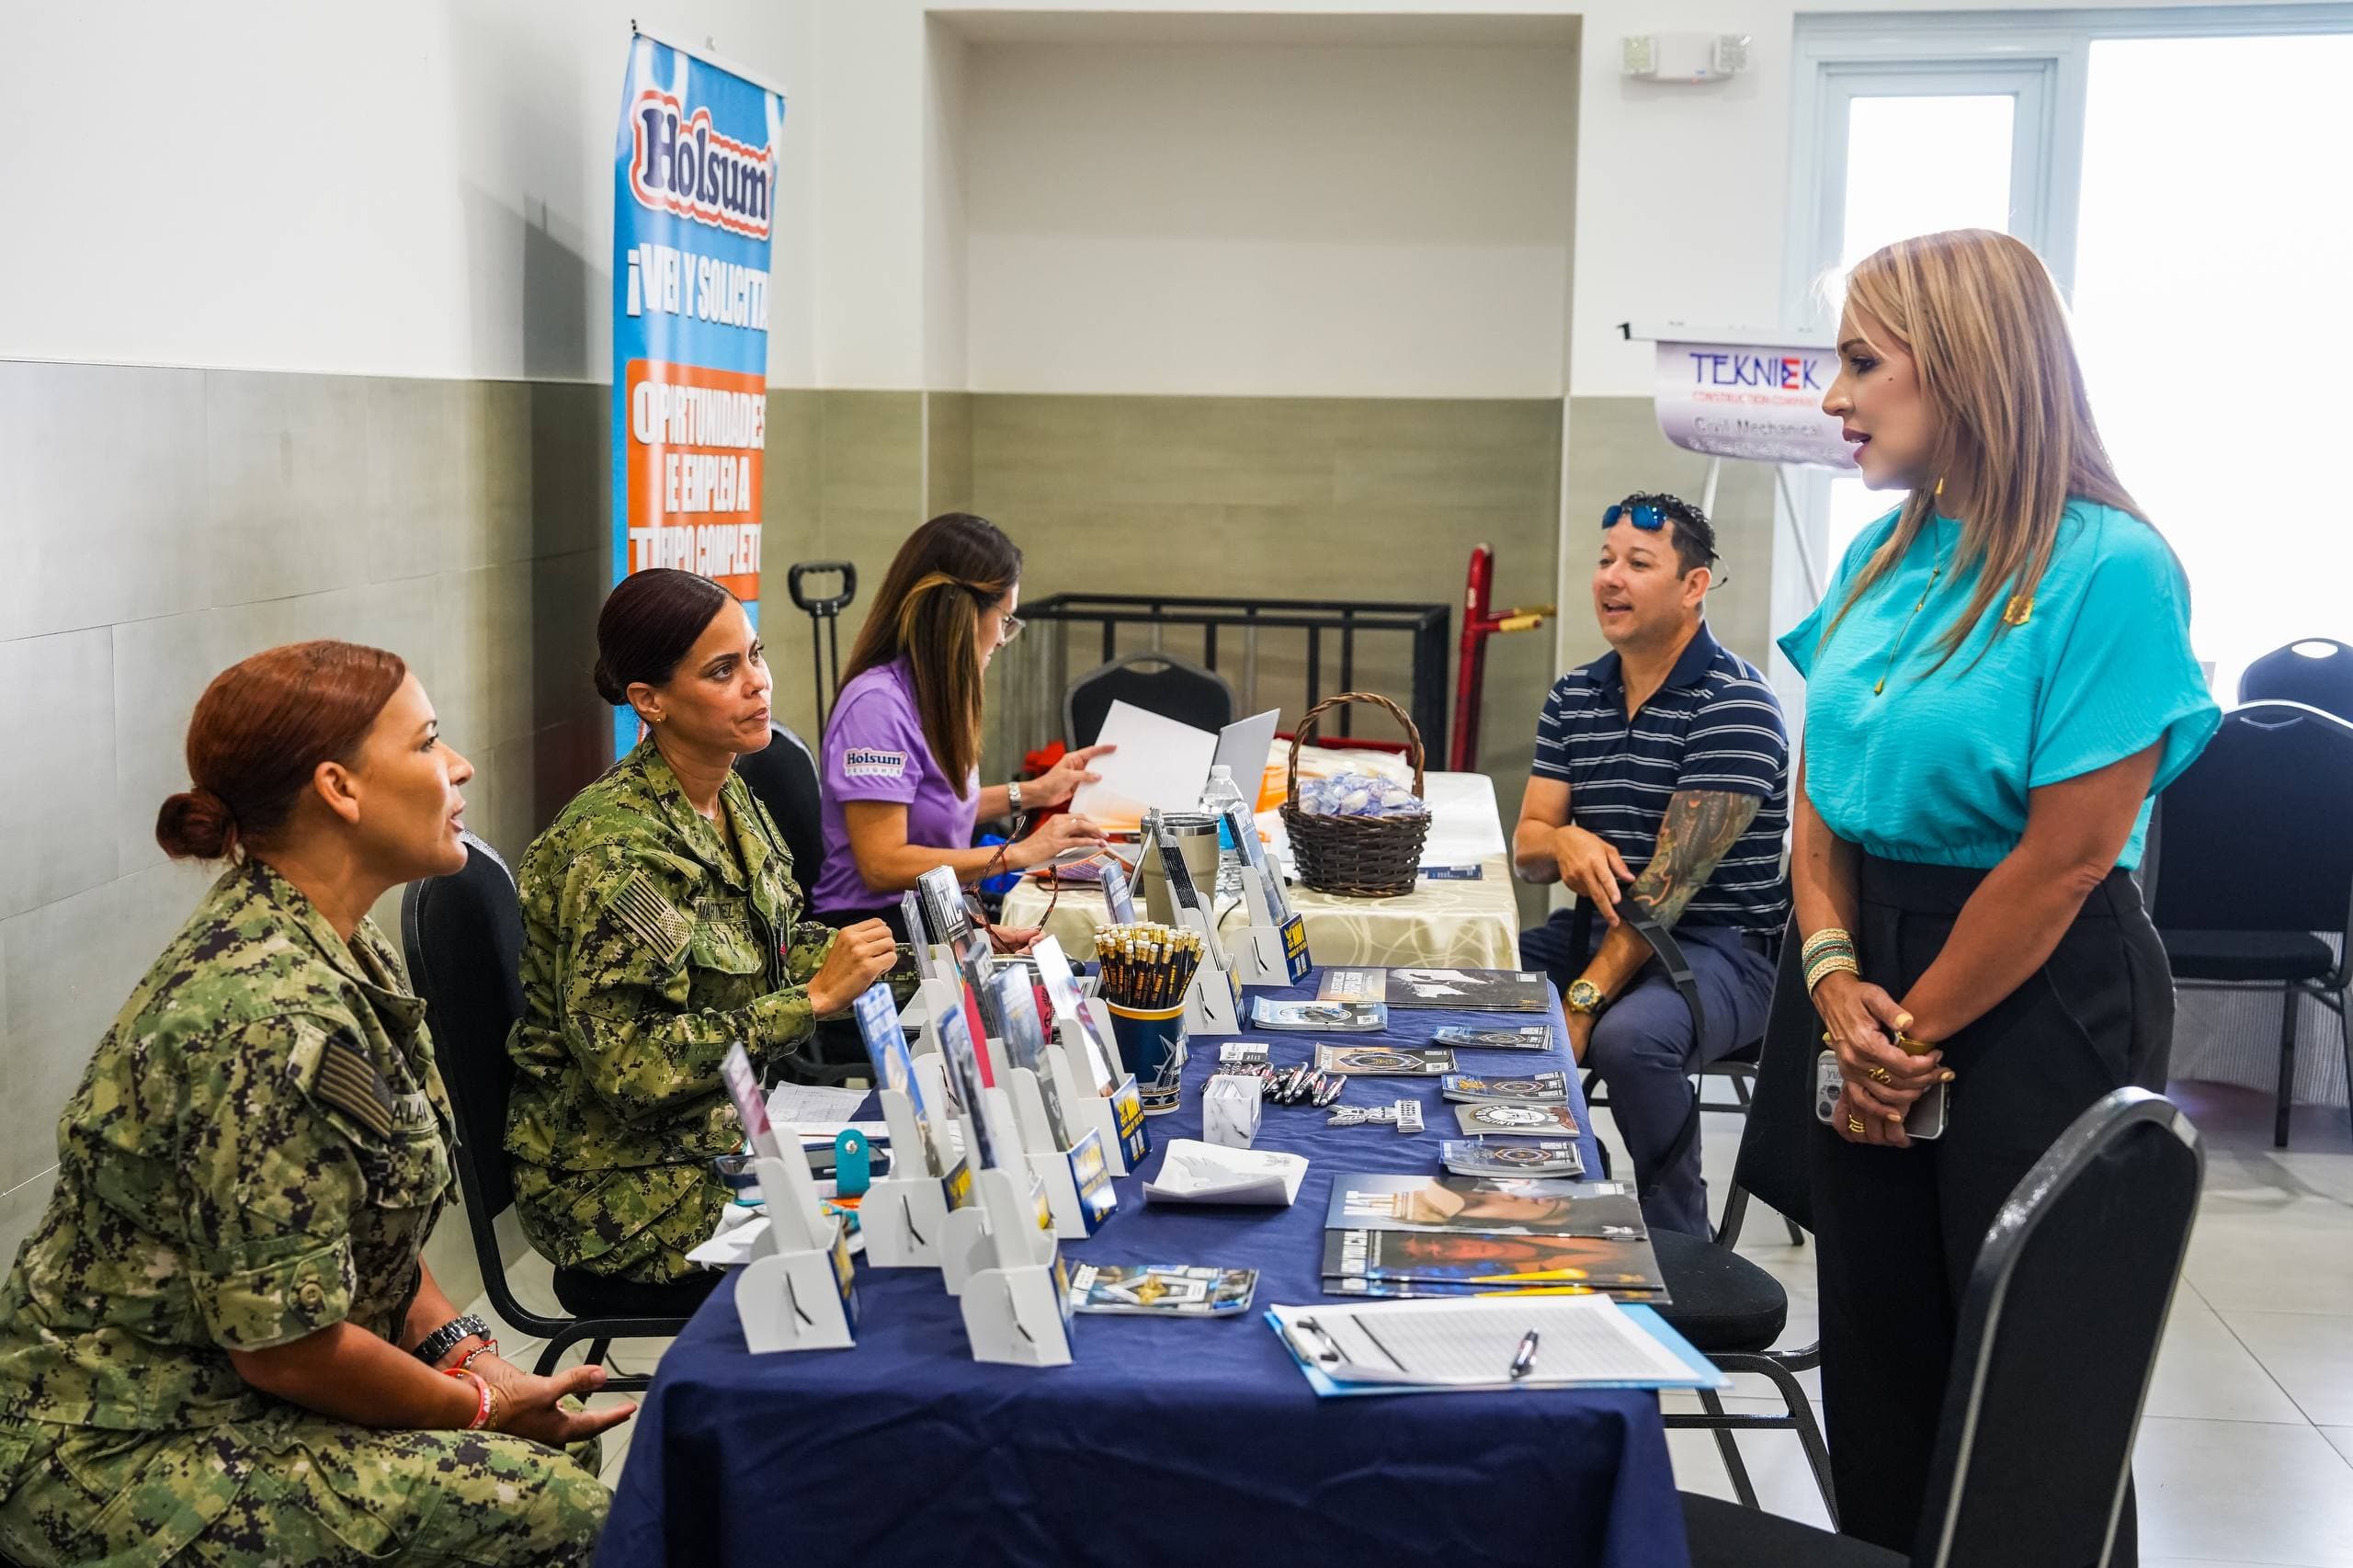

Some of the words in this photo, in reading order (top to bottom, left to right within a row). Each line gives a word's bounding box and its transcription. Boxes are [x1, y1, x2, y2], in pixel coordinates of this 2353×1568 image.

[642, 108, 767, 222] Holsum
[682, 250, 697, 319] Y
[737, 456, 751, 513] A
[847, 752, 901, 766] Holsum
